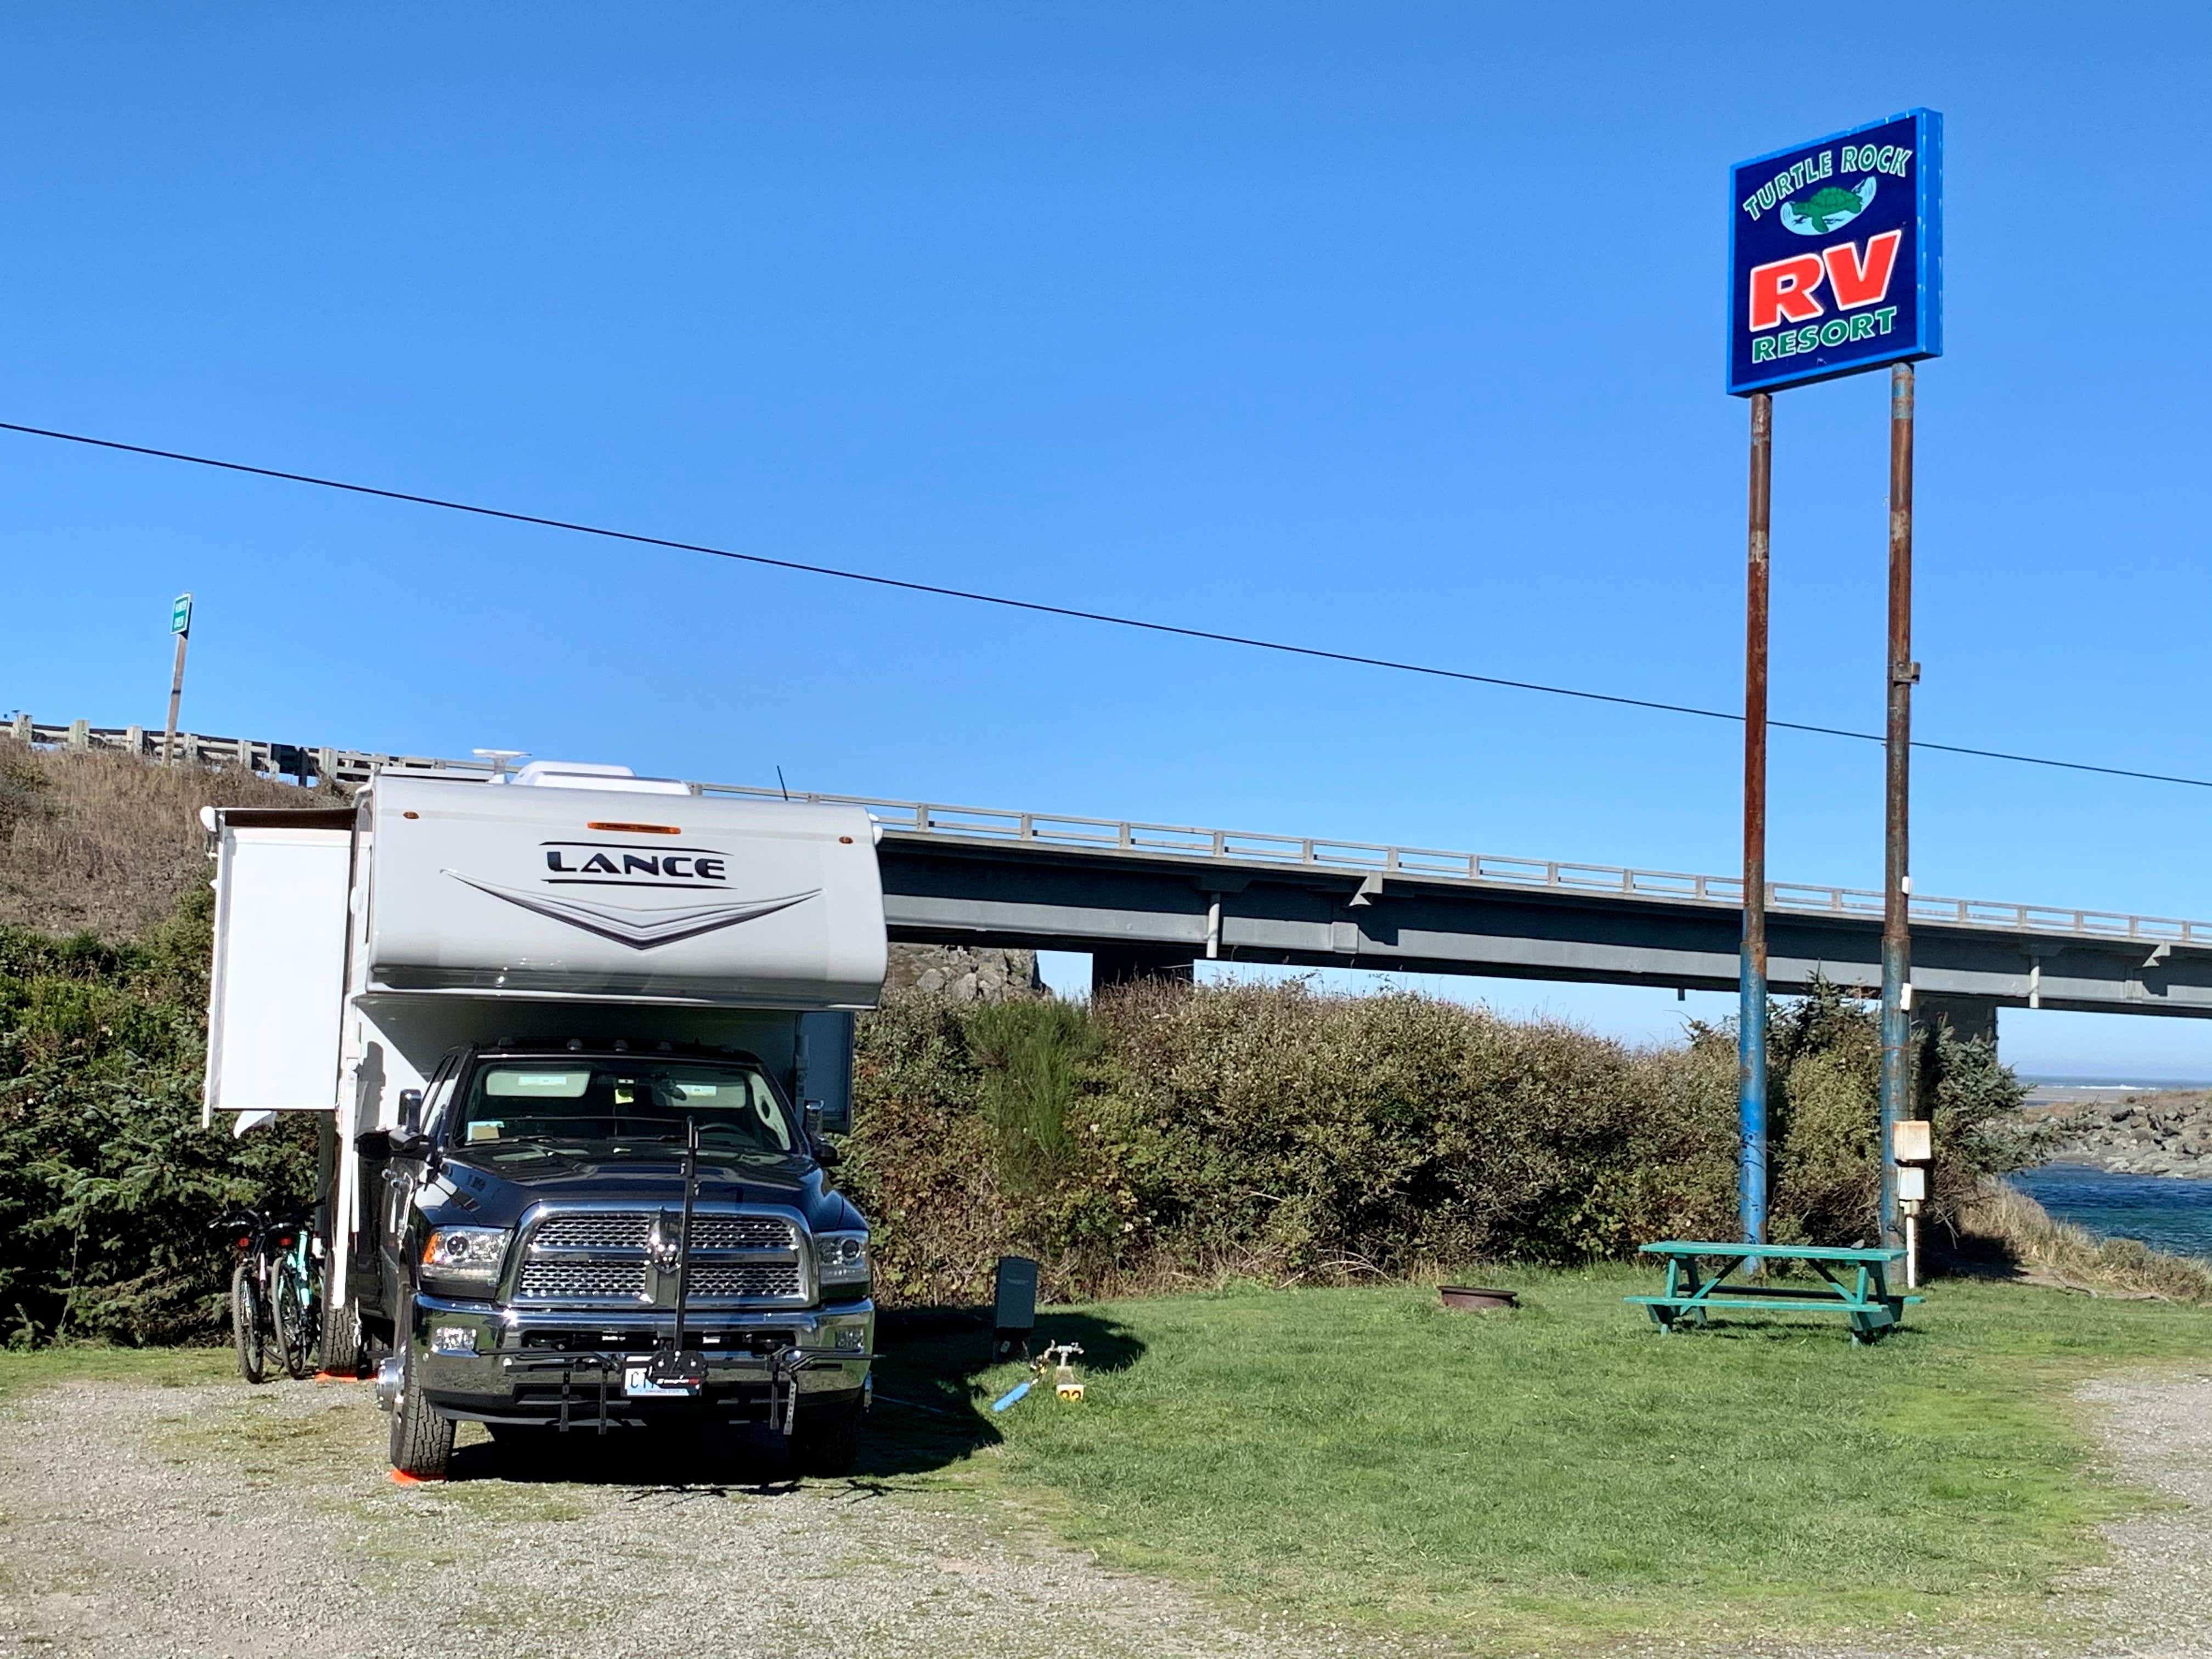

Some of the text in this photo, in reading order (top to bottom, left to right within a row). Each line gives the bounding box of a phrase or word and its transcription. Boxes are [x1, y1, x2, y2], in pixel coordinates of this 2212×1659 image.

[1743, 144, 1912, 221] TURTLE ROCK
[1750, 229, 1901, 332] RV
[1752, 306, 1897, 364] RESORT
[546, 851, 726, 881] LANCE
